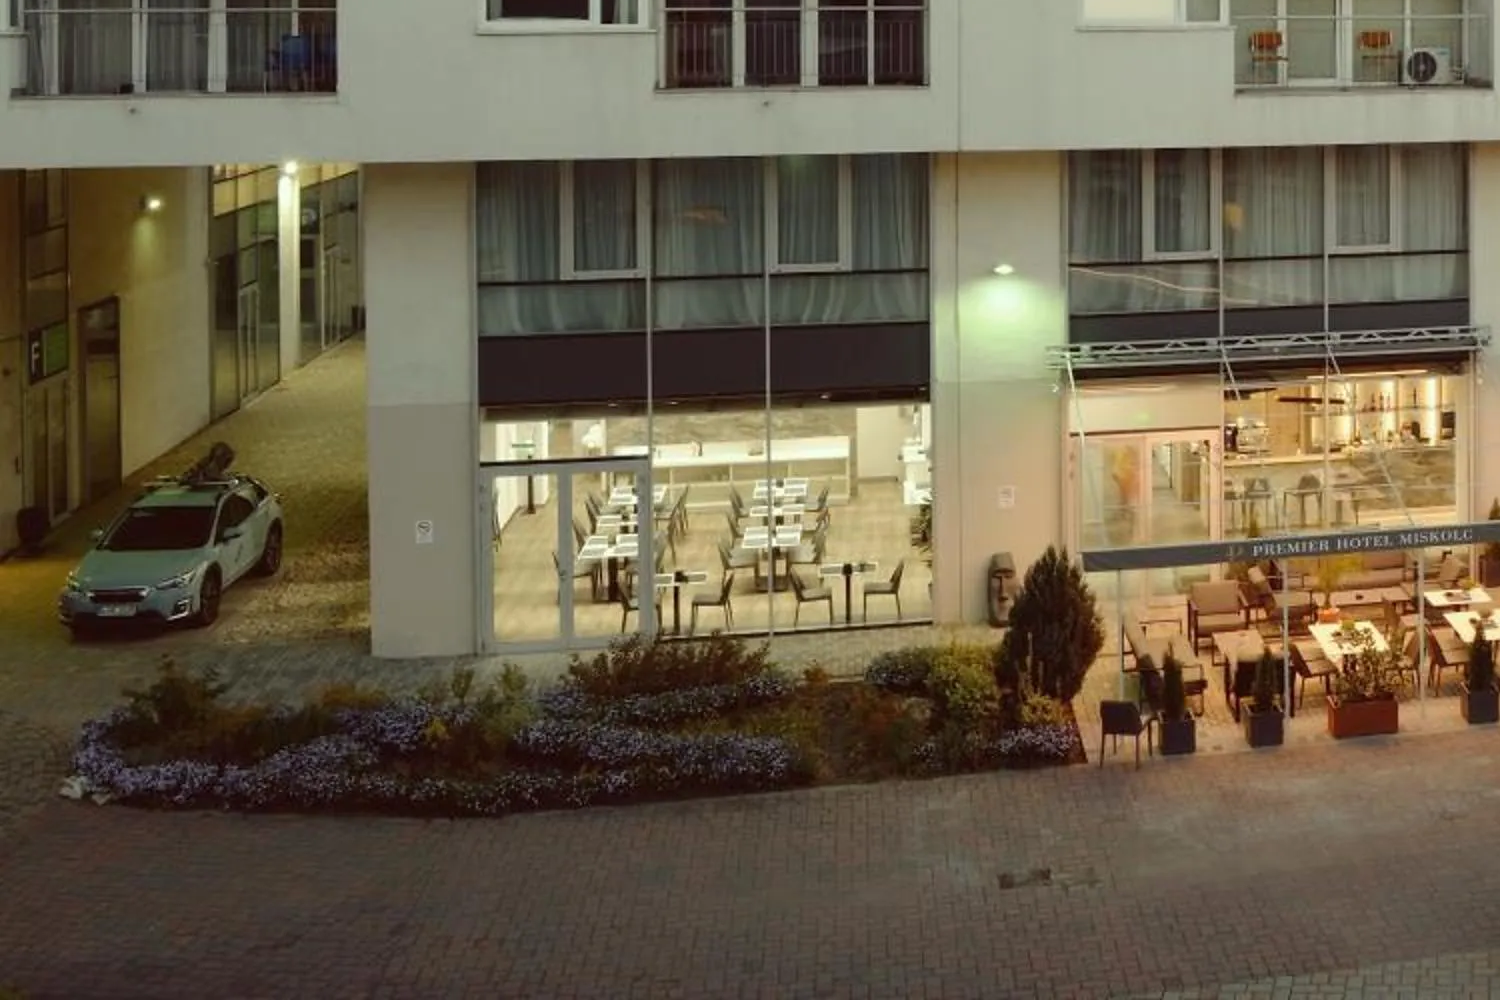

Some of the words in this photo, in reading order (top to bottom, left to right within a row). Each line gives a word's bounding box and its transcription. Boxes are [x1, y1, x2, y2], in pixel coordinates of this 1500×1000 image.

[1252, 539, 1329, 557] PREMIER
[1336, 534, 1393, 551] HOTEL
[1399, 527, 1473, 546] MISKOLC
